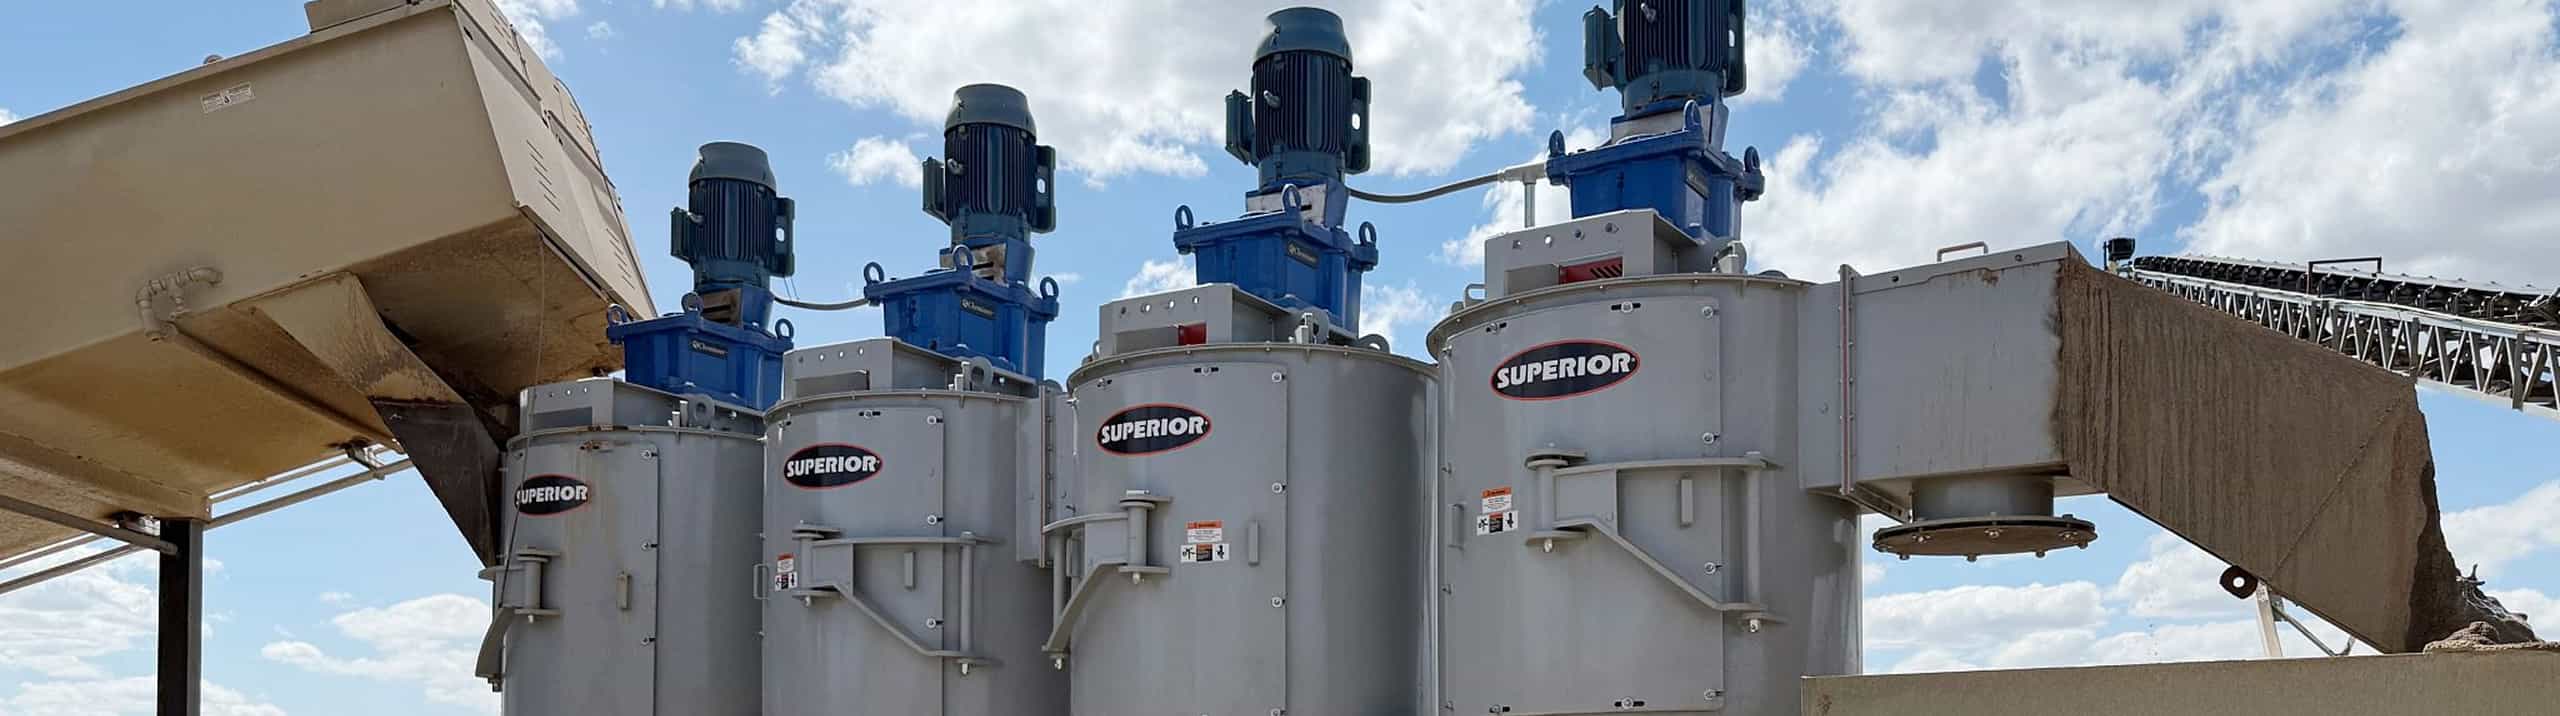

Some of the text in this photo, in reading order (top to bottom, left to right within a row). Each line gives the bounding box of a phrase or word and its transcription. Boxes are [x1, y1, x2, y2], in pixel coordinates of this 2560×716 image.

[1497, 352, 1631, 389] SUPERIOR
[1101, 416, 1205, 444] SUPERIOR
[787, 455, 877, 478] SUPERIOR
